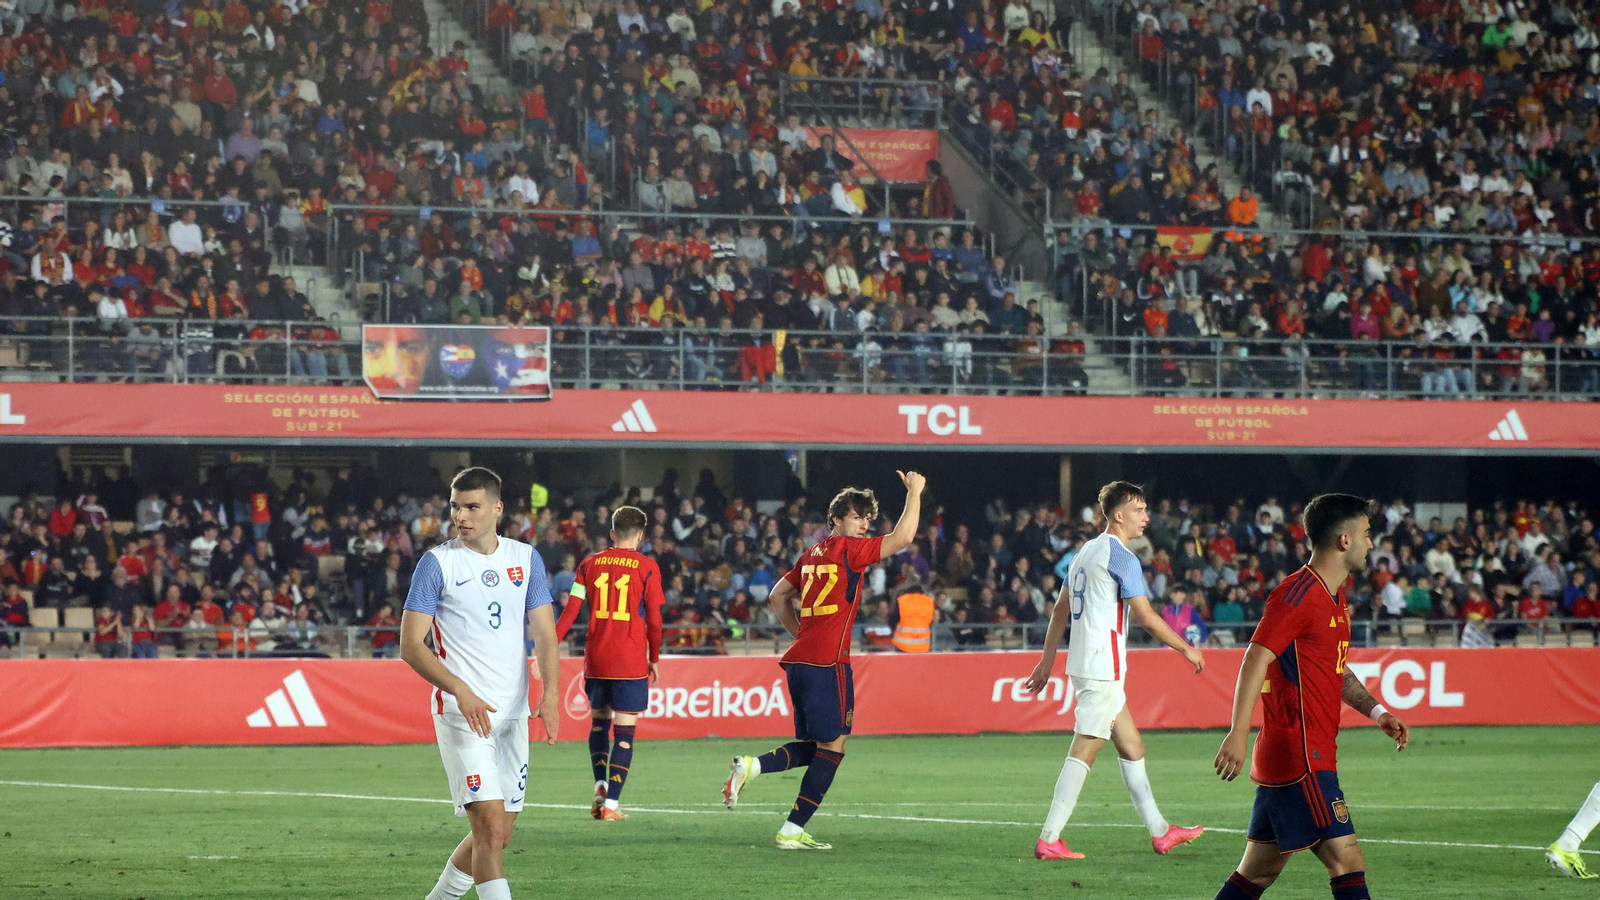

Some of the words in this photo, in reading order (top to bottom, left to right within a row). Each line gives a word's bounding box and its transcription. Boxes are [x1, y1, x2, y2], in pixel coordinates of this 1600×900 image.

[869, 140, 931, 150] ESPAÑOLA
[223, 392, 313, 404] SELECCIÓN
[318, 391, 392, 405] ESPAÑ
[271, 408, 293, 418] DE
[298, 406, 360, 419] FÚTBOL
[1153, 404, 1232, 415] SELECCIÓN
[1236, 404, 1309, 416] ESPAÑOLA
[285, 421, 343, 432] SUB-21
[898, 404, 982, 436] TCL
[1194, 418, 1213, 428] DE
[1217, 417, 1272, 429] FÚTBOL
[1206, 430, 1257, 441] SUB-21
[594, 556, 640, 569] NAVARRO
[594, 572, 631, 622] 11
[801, 563, 838, 617] 22
[1072, 566, 1087, 620] 8
[487, 601, 502, 629] 3
[638, 679, 789, 718] BREIROÁ
[518, 763, 529, 791] 3
